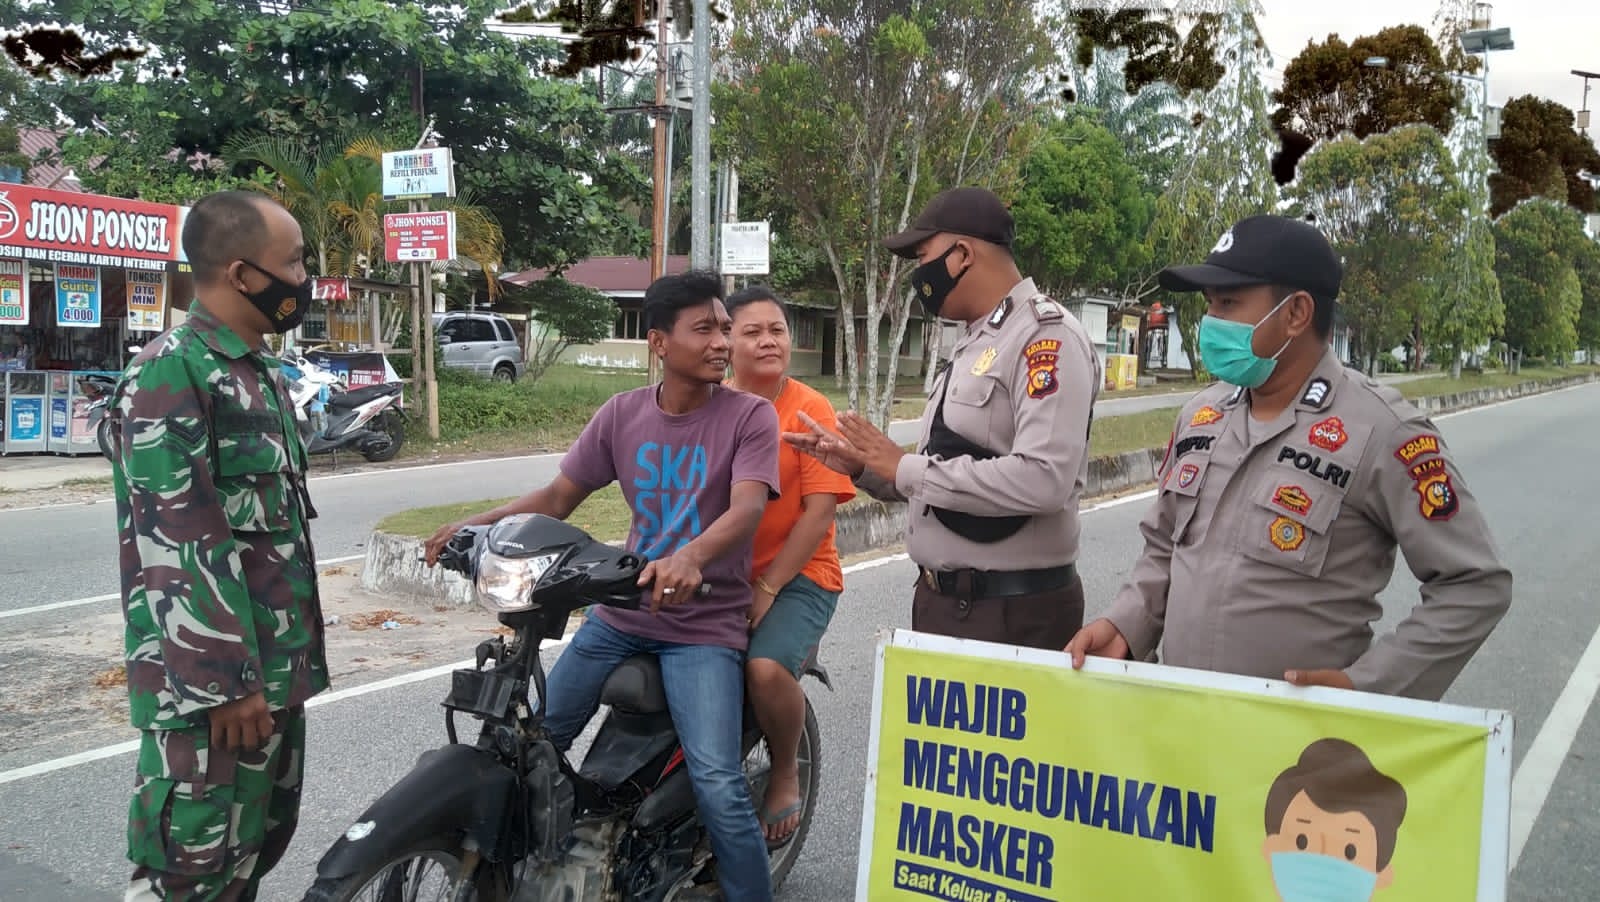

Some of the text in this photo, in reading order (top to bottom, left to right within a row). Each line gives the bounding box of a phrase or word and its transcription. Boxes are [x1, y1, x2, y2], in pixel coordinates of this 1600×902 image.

[25, 201, 170, 253] JHON PONSEL
[394, 215, 445, 228] JHON PONSEL
[25, 247, 47, 260] DAN
[50, 249, 88, 264] ECERAN
[90, 254, 122, 267] KARTU
[123, 257, 167, 271] INTERNET
[59, 266, 96, 280] MURAH
[60, 281, 96, 292] Gurita
[128, 270, 162, 283] TONGSIS
[134, 286, 154, 295] OTG
[132, 295, 156, 305] MINI
[633, 441, 707, 490] SKA
[1277, 446, 1351, 488] POLRI
[1413, 459, 1442, 475] RIAU
[634, 491, 701, 537] SKA
[906, 675, 1027, 741] WAJIB
[903, 738, 1217, 853] MENGGUNAKAN
[896, 801, 1055, 888] MASKER
[897, 865, 936, 892] Saat
[939, 874, 991, 902] Keluar
